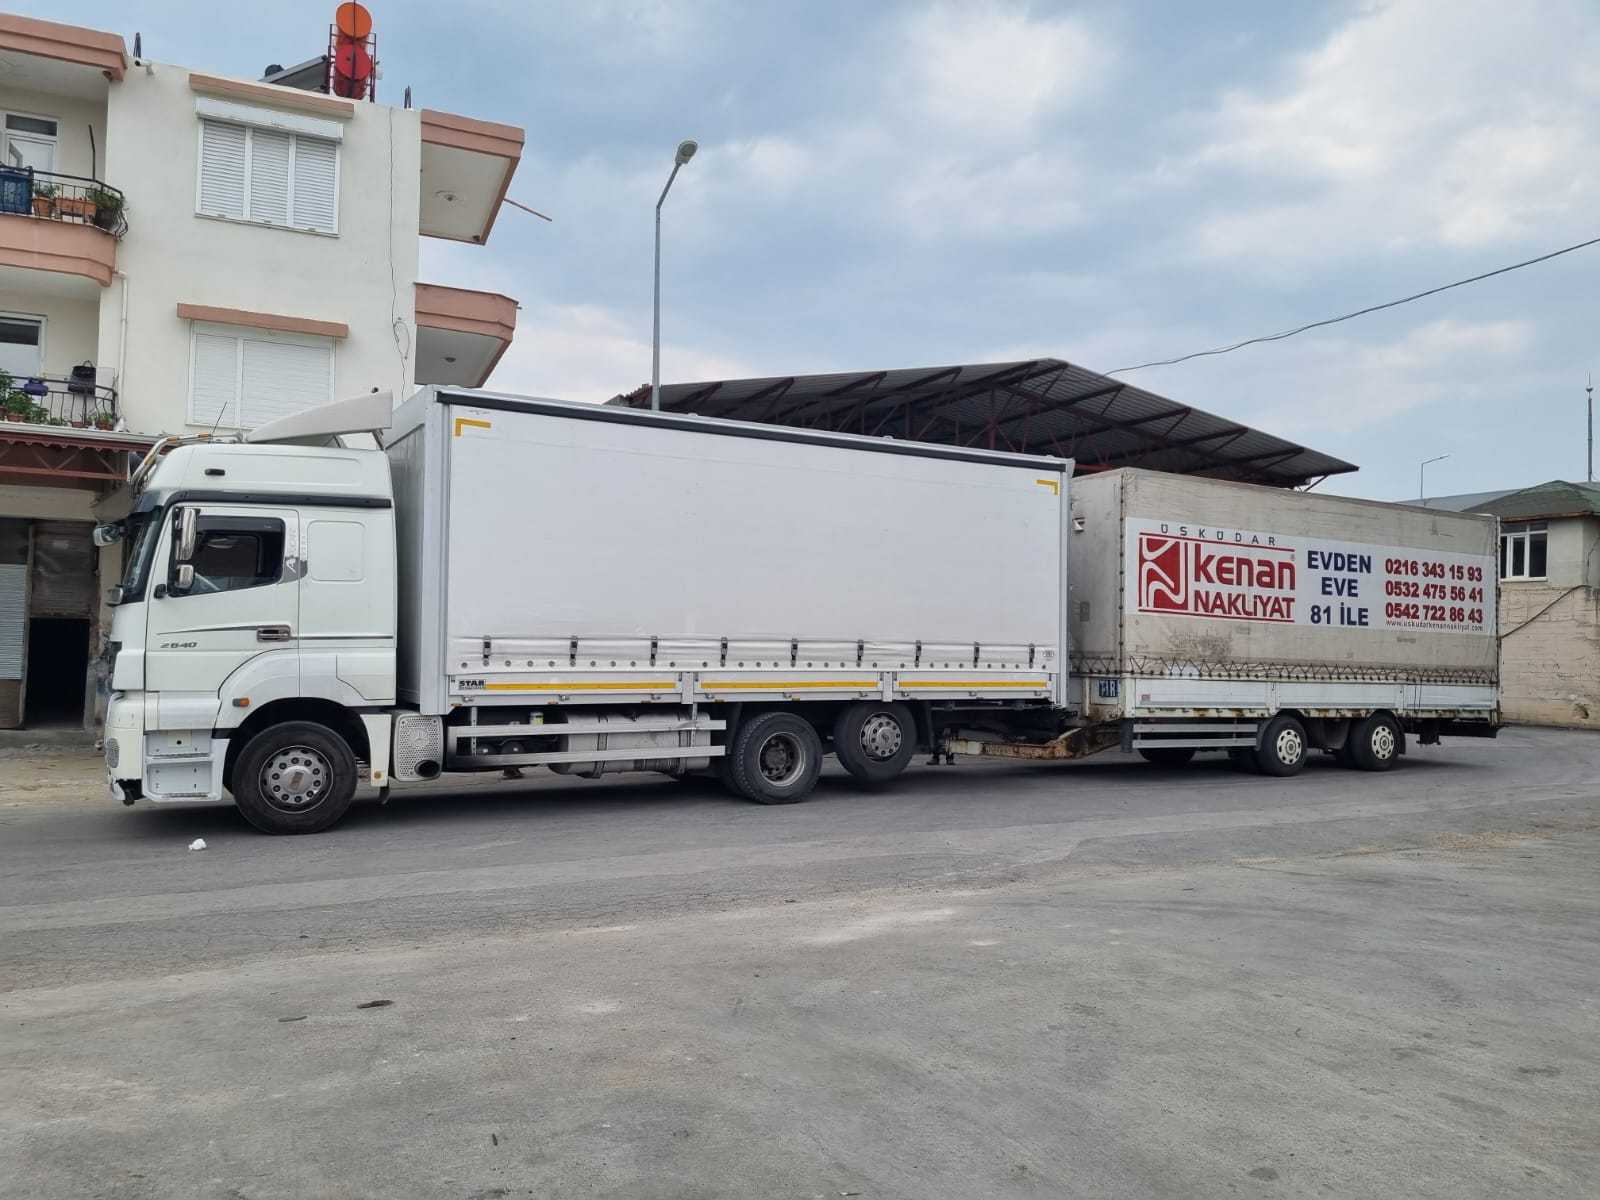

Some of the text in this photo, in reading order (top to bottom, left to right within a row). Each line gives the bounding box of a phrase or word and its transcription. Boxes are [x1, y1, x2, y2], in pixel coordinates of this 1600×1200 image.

[1194, 542, 1296, 591] kenan
[1307, 550, 1372, 574] EVDEN
[1385, 558, 1483, 582] 0216 343 15 93
[1321, 576, 1359, 598] EVE
[1385, 580, 1483, 603] 0532 475 56 41
[1310, 601, 1369, 626] 81 İLE
[1385, 602, 1483, 624] 0542 722 86 43
[1100, 680, 1117, 697] TIR
